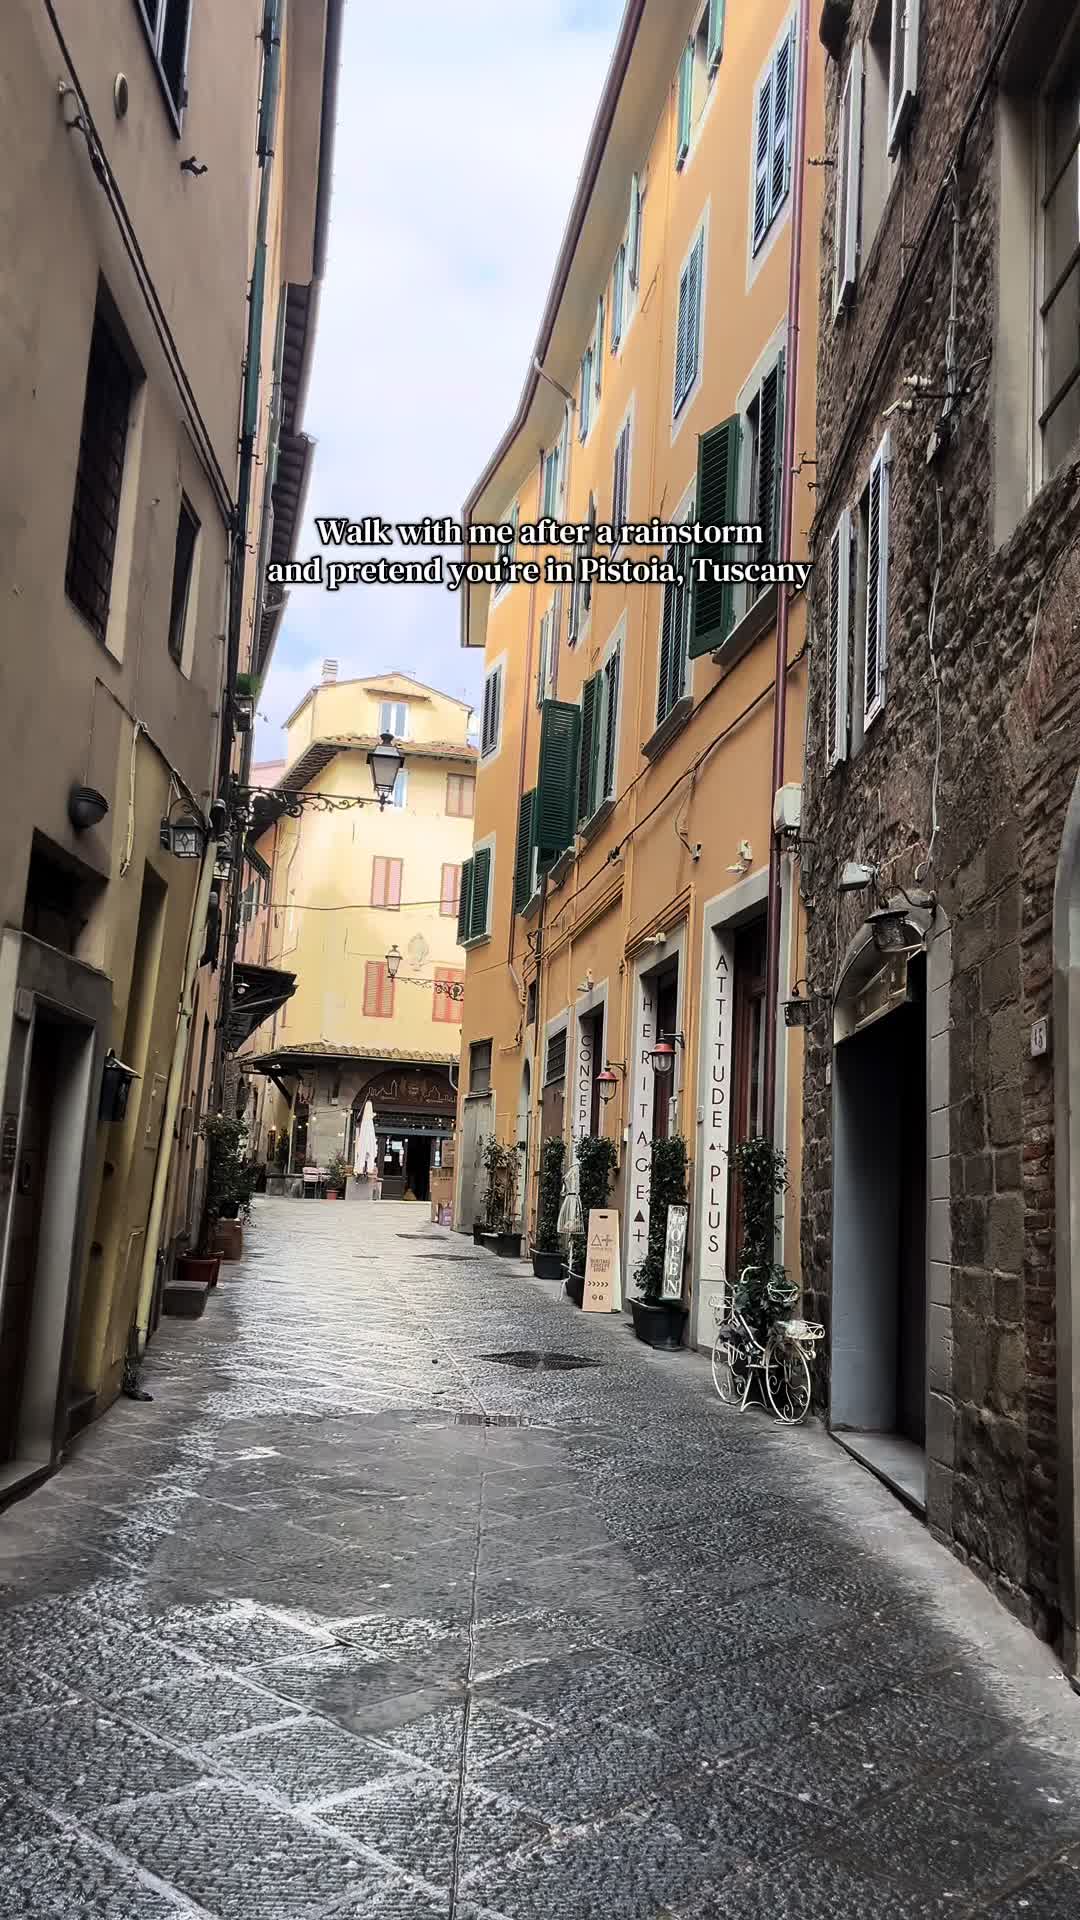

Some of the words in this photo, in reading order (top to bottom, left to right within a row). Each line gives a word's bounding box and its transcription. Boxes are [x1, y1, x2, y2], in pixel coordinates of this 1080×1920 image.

[579, 1034, 593, 1138] CONCEPT
[711, 954, 729, 1128] ATTITUDE
[635, 997, 653, 1200] HERITAGE
[708, 1165, 722, 1253] PLUS
[667, 1228, 682, 1295] OPEN
